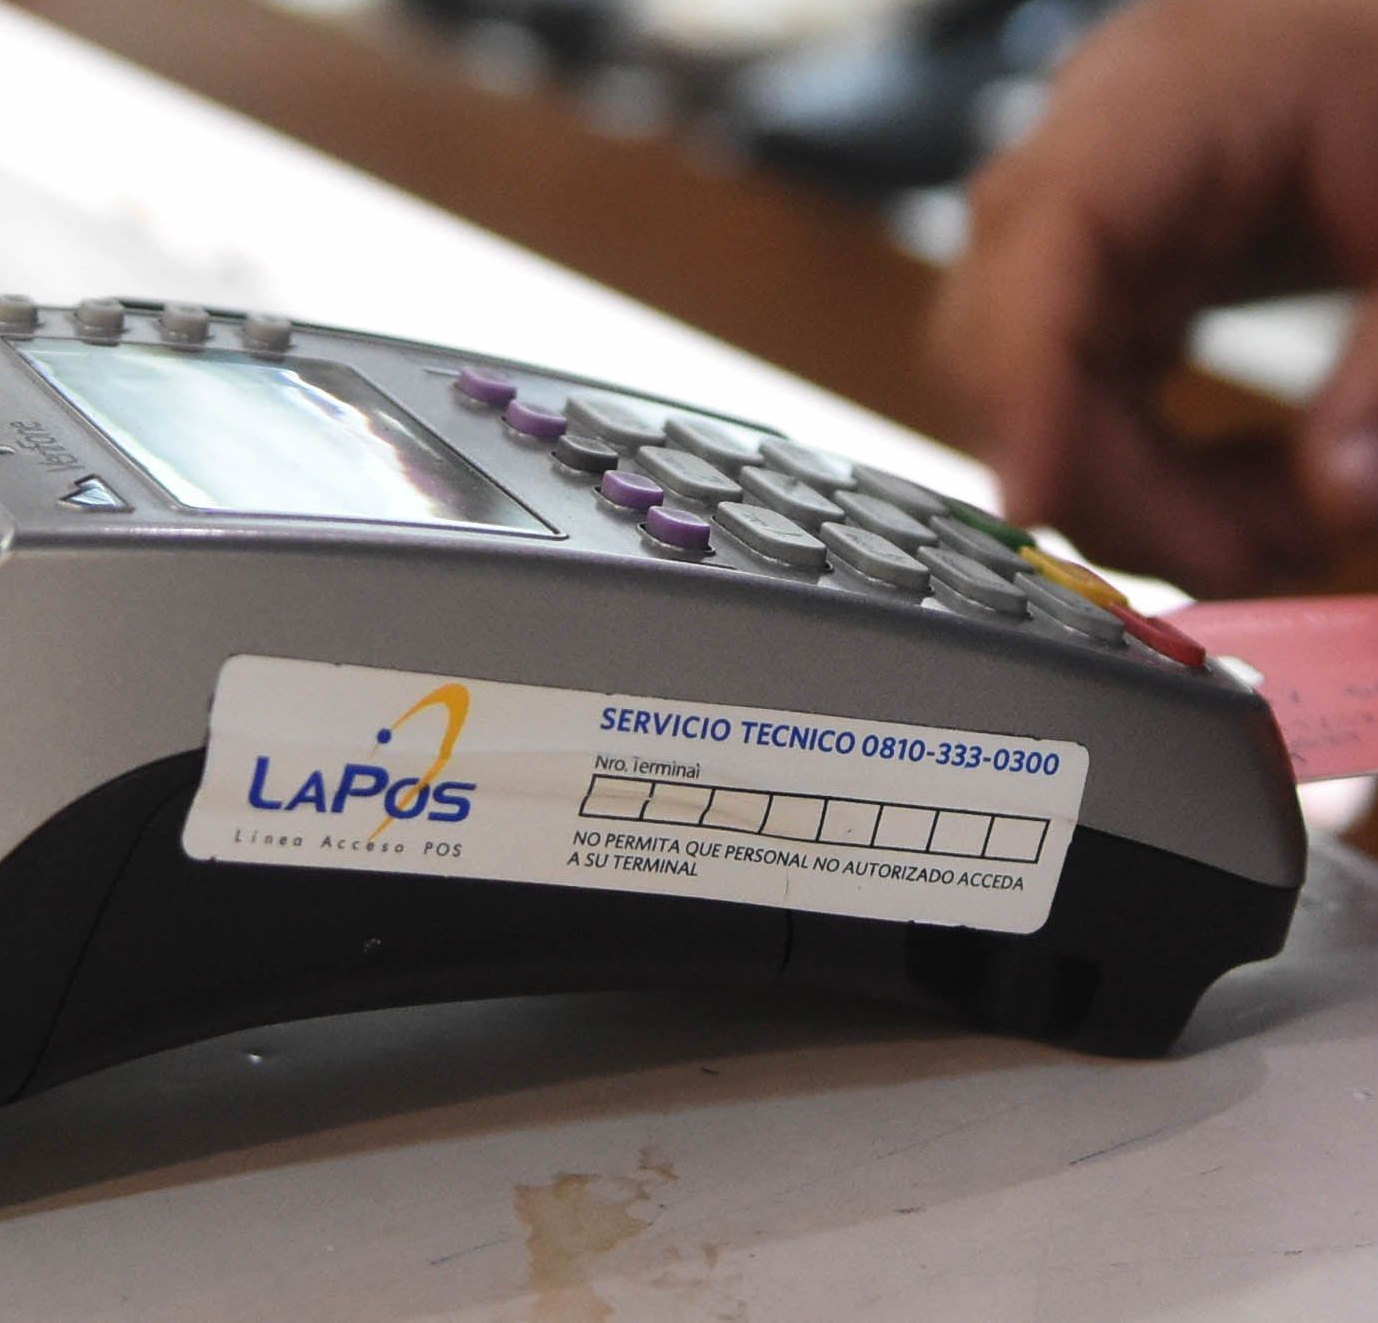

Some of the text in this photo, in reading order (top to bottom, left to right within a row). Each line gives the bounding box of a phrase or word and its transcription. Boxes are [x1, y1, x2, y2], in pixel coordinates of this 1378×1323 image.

[600, 707, 1060, 776] SERVICIO TECNICO 0810-333-0300
[595, 754, 701, 779] Nro. Terminal
[320, 835, 405, 854] Acceso
[423, 841, 463, 858] POS
[567, 851, 699, 877] A SU TERMINAL
[573, 830, 1024, 891] NO PERMITA QUE PERSONAL NO AUTORIZADO ACCEDA
